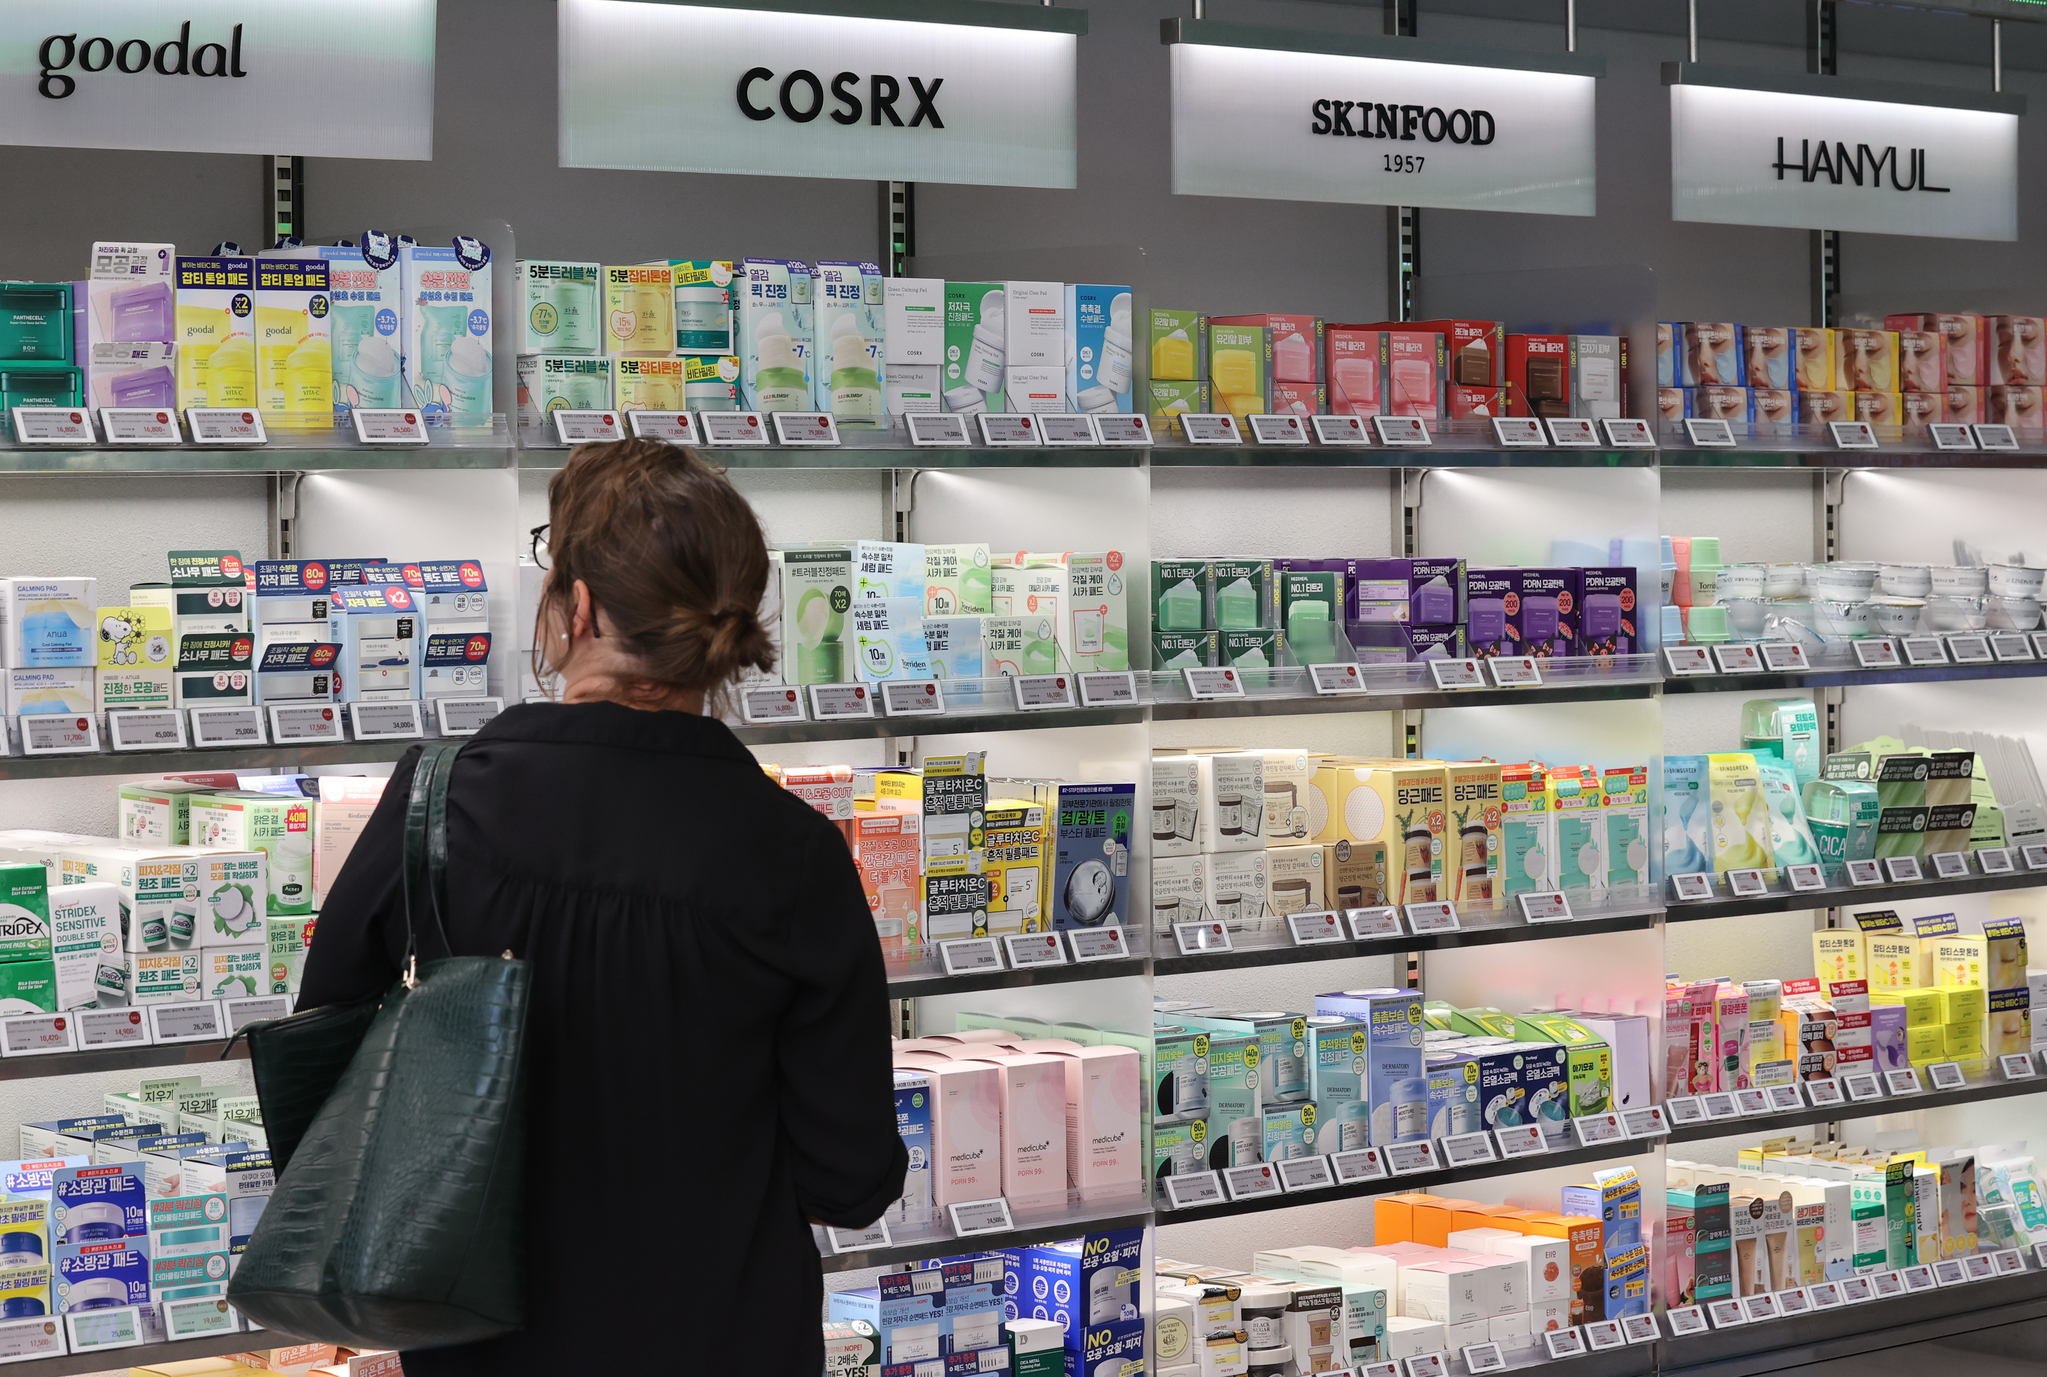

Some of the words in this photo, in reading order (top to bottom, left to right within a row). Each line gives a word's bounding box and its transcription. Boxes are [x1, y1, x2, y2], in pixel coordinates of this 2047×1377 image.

[38, 20, 247, 99] goodal
[736, 67, 945, 128] COSRX
[1312, 99, 1496, 145] SKINFOOD
[1383, 153, 1426, 174] 1957
[1772, 136, 1950, 192] HANYUL
[95, 255, 130, 275] 모공
[131, 256, 148, 265] 교정
[227, 262, 248, 270] goodal
[182, 272, 204, 285] 잡티
[205, 272, 226, 285] 톤업
[227, 273, 248, 286] 패드
[260, 273, 281, 286] 잡티
[283, 274, 304, 286] 톤업
[305, 274, 326, 287] 패드
[750, 268, 769, 282] 열감
[751, 284, 763, 299] 퀵
[765, 284, 787, 299] 진정
[825, 284, 837, 299] 퀵
[839, 284, 860, 299] 진정
[948, 302, 970, 312] 저자극
[1080, 304, 1101, 314] 촉촉결
[1080, 314, 1105, 324] 수분패드
[266, 326, 292, 338] goodal
[1216, 335, 1236, 345] 유리알
[1238, 335, 1252, 345] 피부
[1335, 341, 1347, 351] 탄력
[1348, 341, 1366, 351] 콜라겐
[1393, 342, 1405, 352] 탄력
[1406, 343, 1423, 353] 콜라겐
[170, 557, 177, 566] 한
[178, 557, 190, 566] 장에
[861, 553, 880, 561] 속수분
[881, 553, 893, 561] 밀착
[222, 559, 239, 568] 7cm
[260, 565, 277, 573] 초밀착
[172, 566, 200, 578] 소나무
[202, 566, 221, 577] 패드
[306, 568, 325, 579] 80매
[462, 568, 480, 578] 70매
[792, 567, 846, 578] #트러블진정패드
[259, 575, 278, 586] 자작
[280, 574, 299, 586] 패드
[1072, 575, 1087, 585] 각질
[1089, 575, 1103, 584] 케어
[1469, 581, 1487, 590] PDRN
[1488, 580, 1511, 590] 모공탄력
[1523, 579, 1541, 589] PDRN
[1541, 579, 1564, 589] 모공탄력
[1585, 577, 1604, 586] PDRN
[1605, 577, 1627, 586] 모공탄력
[1290, 583, 1307, 593] NO.1
[1309, 583, 1323, 592] 티트리
[835, 599, 847, 609] X2
[1505, 600, 1518, 608] 200
[1559, 599, 1571, 607] 200
[854, 611, 873, 619] 속수분
[875, 610, 887, 618] 밀착
[990, 628, 1004, 638] 각질
[1007, 628, 1021, 638] 케어
[990, 641, 1004, 650] 시카
[1007, 640, 1021, 650] 패드
[1161, 640, 1177, 649] NO.1
[1178, 639, 1196, 649] 티트리
[869, 648, 886, 660] 10매
[925, 779, 982, 793] 글루타치온C
[1398, 777, 1420, 786] #열감진정
[1397, 787, 1443, 804] 당근패드
[1454, 784, 1498, 801] 당근패드
[925, 796, 944, 811] 흔적
[946, 794, 983, 809] 필름패드
[253, 814, 268, 824] 맑은
[270, 814, 279, 824] 결
[288, 812, 307, 823] 40매
[1061, 810, 1105, 827] 결/광/톤
[986, 830, 1040, 846] 글루타치온C
[1060, 828, 1083, 839] 부스터
[1086, 827, 1106, 838] 필패드
[1819, 835, 1846, 855] CICA
[986, 849, 1003, 863] 흔적
[1005, 847, 1040, 860] 필름패드
[210, 871, 230, 881] 모공을
[232, 870, 259, 880] 확실하게
[869, 870, 890, 884] 더블
[893, 868, 912, 882] 기획
[54, 907, 97, 920] STRIDEX
[56, 917, 106, 932] SENSITIVE
[57, 933, 82, 943] DOUBLE
[83, 931, 99, 941] SET
[1819, 939, 1832, 948] 잡티
[1845, 939, 1855, 948] 톤업
[1372, 1010, 1405, 1024] 촘촘보습
[1372, 1024, 1408, 1036] 속수분패드
[1319, 1051, 1349, 1063] 진정패드
[1526, 1067, 1560, 1080] 온열소금팩
[1572, 1062, 1594, 1073] 아기모공
[1482, 1073, 1518, 1088] 온열소금팩
[1092, 1134, 1121, 1145] medicube
[1017, 1143, 1047, 1154] medicube
[951, 1152, 981, 1162] medicube
[58, 1179, 107, 1196] #소방관
[110, 1174, 136, 1192] 패드
[153, 1200, 175, 1213] #3분
[177, 1198, 203, 1211] 퀵진정
[1797, 1205, 1825, 1217] 생기톤업
[125, 1206, 143, 1219] 10매
[1571, 1229, 1600, 1243] 촉촉탱글
[1084, 1237, 1110, 1255] NO
[61, 1256, 110, 1273] #소방관
[113, 1250, 139, 1268] 패드
[944, 1266, 957, 1275] 추가
[988, 1297, 1003, 1307] YES!
[929, 1309, 944, 1319] YES!
